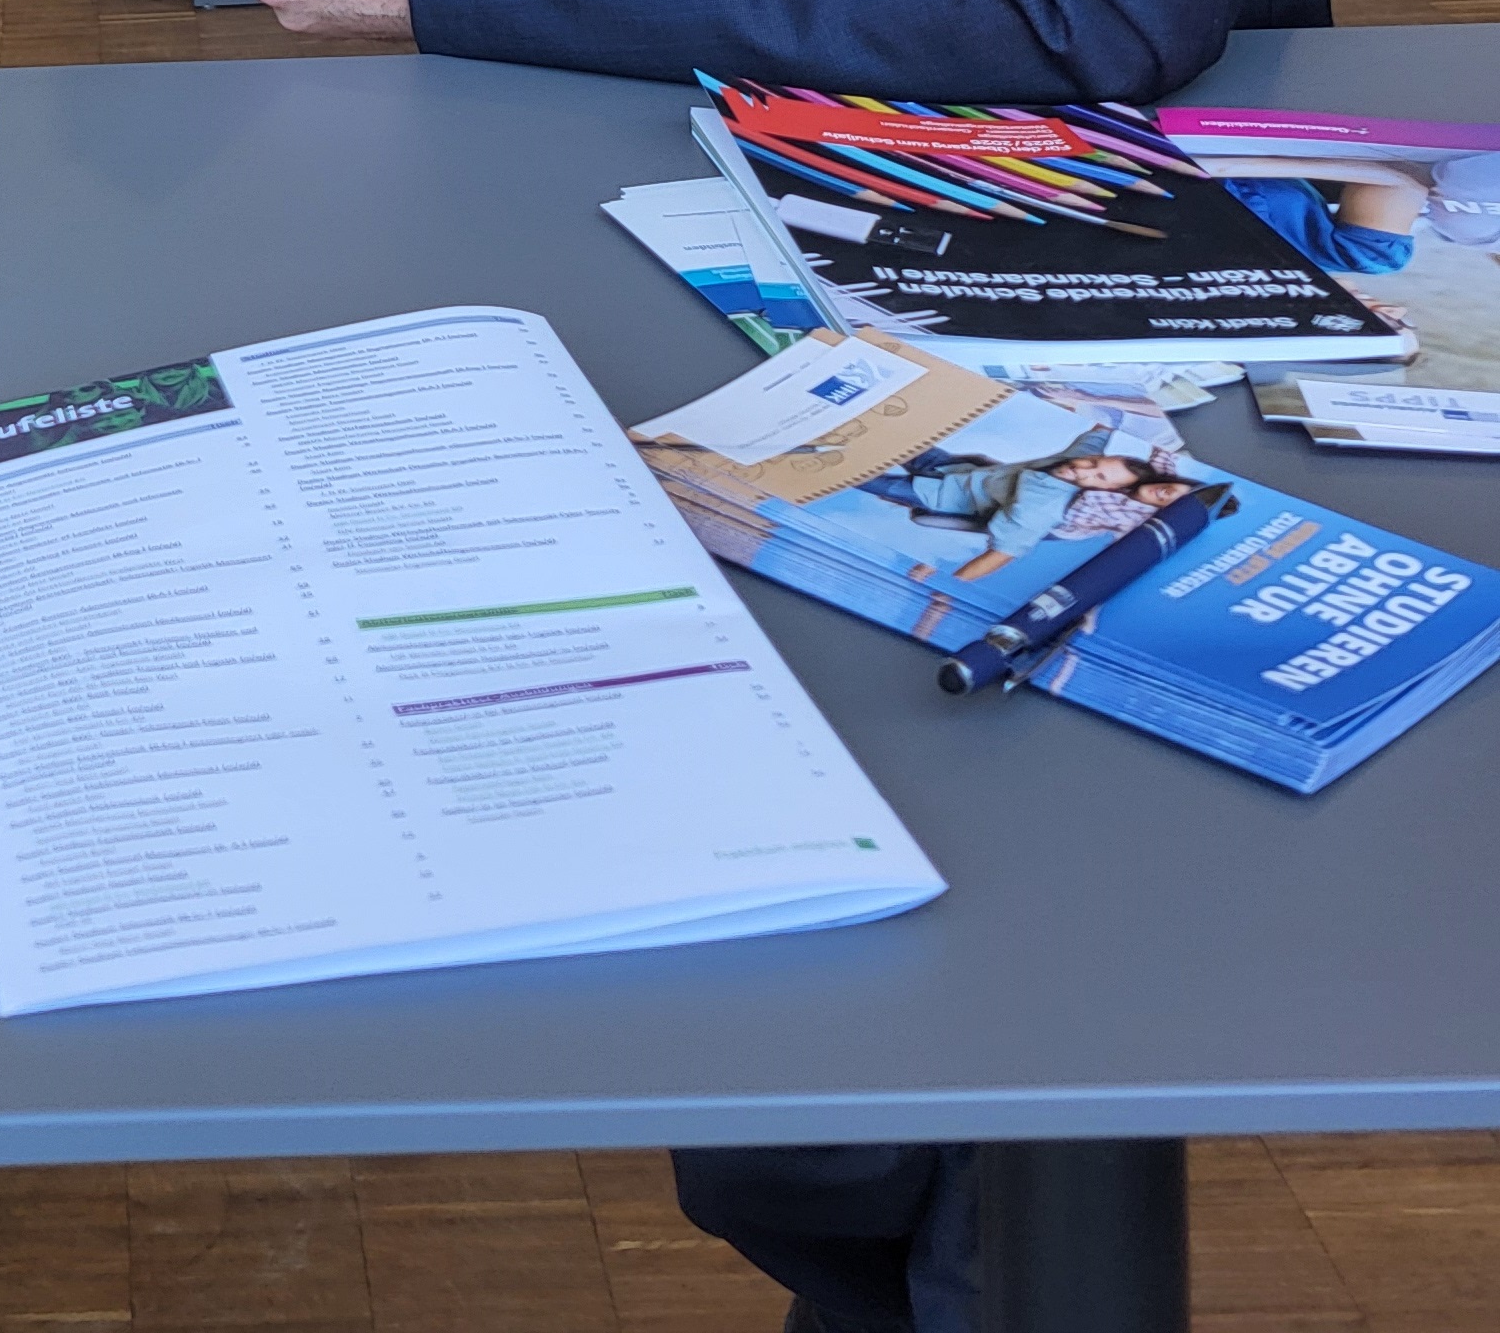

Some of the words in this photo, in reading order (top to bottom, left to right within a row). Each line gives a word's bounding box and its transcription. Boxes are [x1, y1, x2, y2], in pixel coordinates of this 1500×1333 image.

[822, 131, 896, 147] Schuljahr
[896, 138, 929, 148] zum
[931, 141, 1011, 154] Übergang
[1011, 143, 1043, 153] den
[1044, 142, 1073, 152] Für
[900, 267, 1159, 288] Sekundarstufe
[1185, 268, 1262, 285] Köln
[896, 281, 1045, 302] Schulen
[1046, 283, 1331, 302] Weiterführende
[1147, 317, 1217, 331] Köln
[1219, 316, 1299, 330] Stadt
[822, 381, 859, 404] IHK
[1159, 535, 1272, 599] ÜBERFLIEGER
[1228, 531, 1379, 623] ABITUR
[1301, 551, 1424, 628] OHNE
[1259, 565, 1474, 693] STUDIEREN
